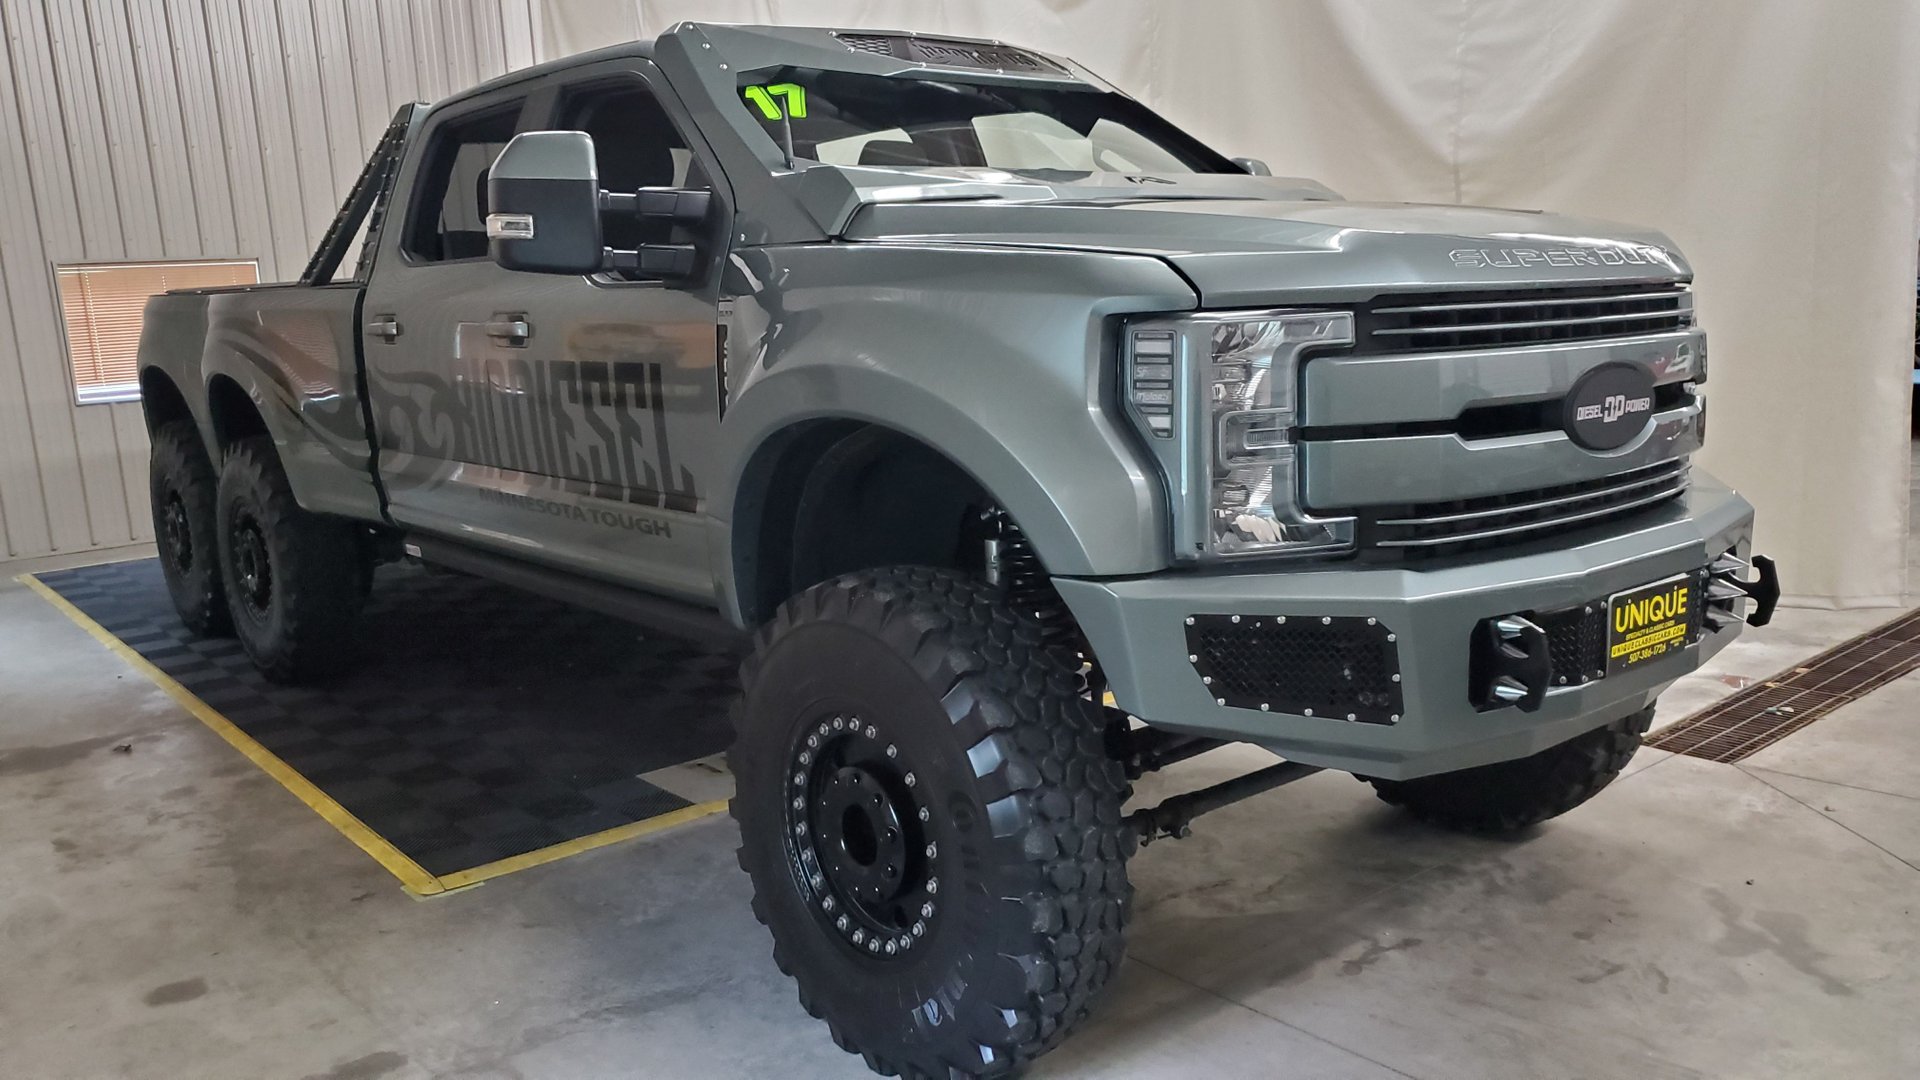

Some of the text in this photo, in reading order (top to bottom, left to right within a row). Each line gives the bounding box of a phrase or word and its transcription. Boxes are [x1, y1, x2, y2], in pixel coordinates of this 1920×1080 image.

[745, 83, 806, 120] 17
[1577, 404, 1603, 421] DIESEL
[1625, 397, 1650, 413] POWER
[587, 508, 672, 538] TOUGH
[1615, 588, 1688, 633] UNIQUE
